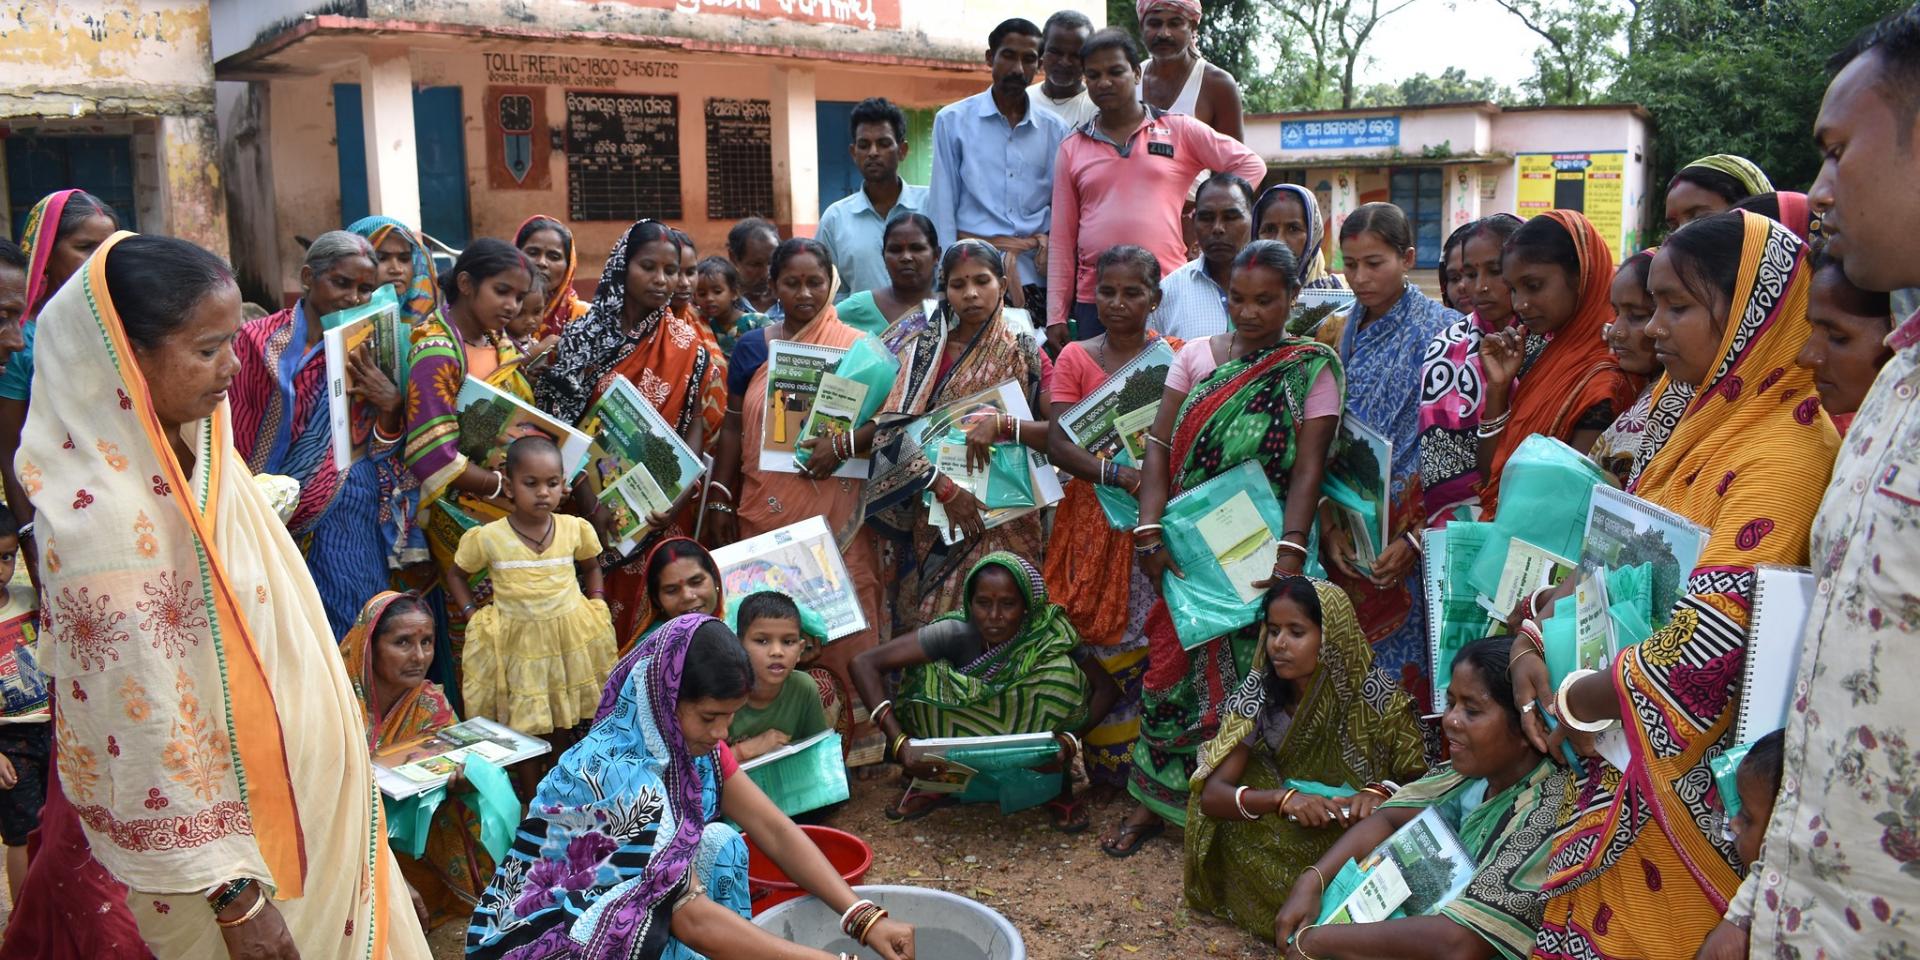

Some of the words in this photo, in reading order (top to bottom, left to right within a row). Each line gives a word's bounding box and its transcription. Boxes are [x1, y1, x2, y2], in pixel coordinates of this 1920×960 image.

[483, 53, 519, 72] TOLL
[520, 54, 555, 75] FREE
[622, 60, 679, 79] 3456722
[4, 663, 18, 674] 25
